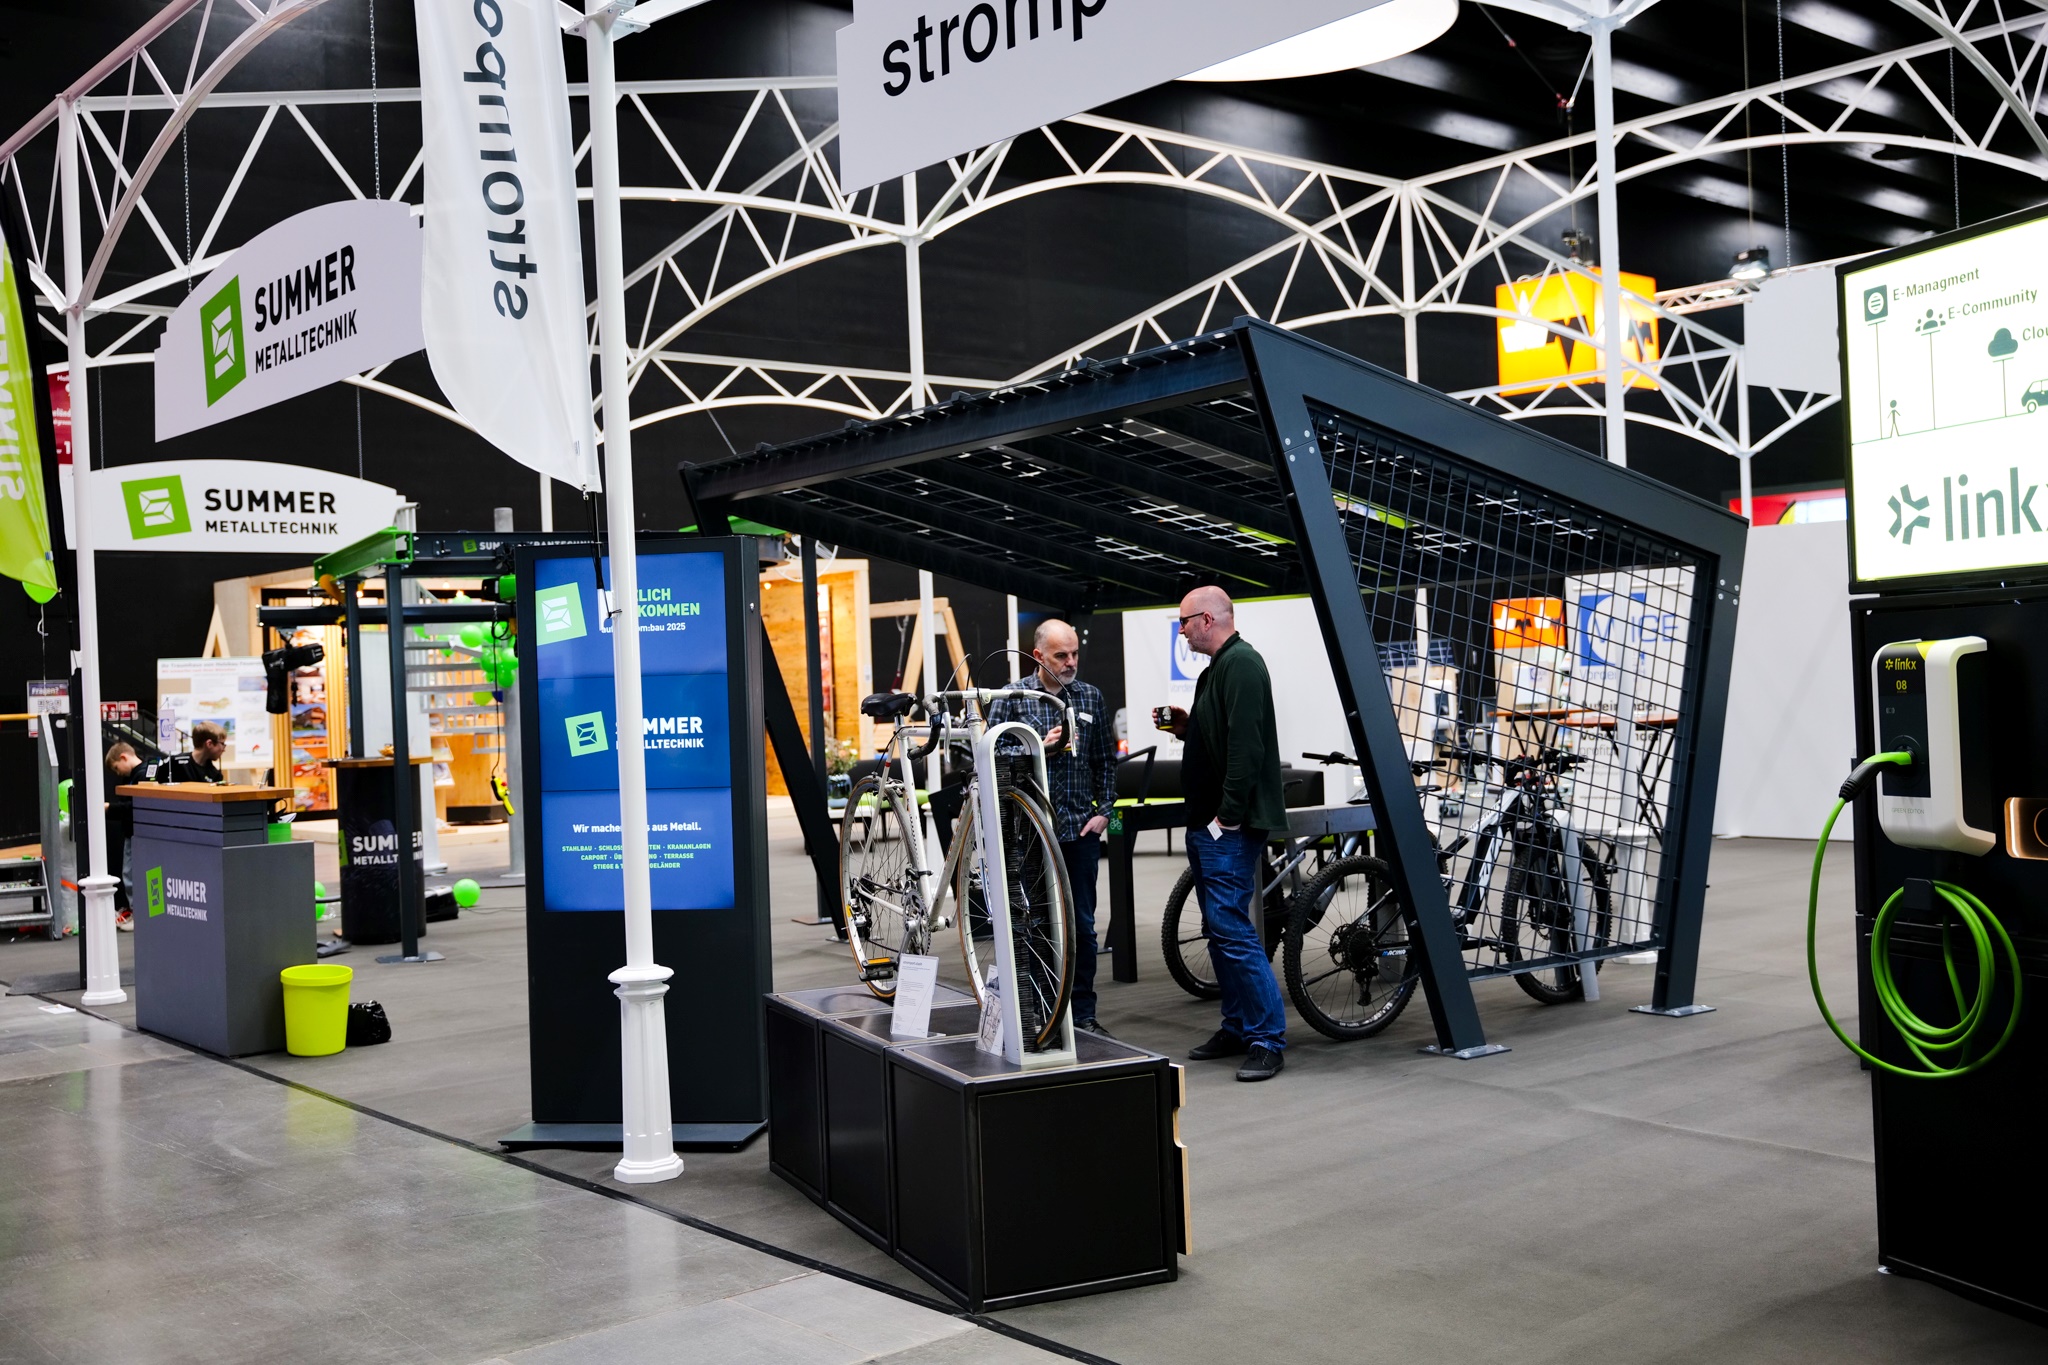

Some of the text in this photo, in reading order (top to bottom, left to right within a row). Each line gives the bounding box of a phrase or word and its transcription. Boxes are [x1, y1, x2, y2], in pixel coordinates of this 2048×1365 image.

[254, 244, 356, 333] SUMMER
[1893, 268, 1980, 301] E-Managment
[1948, 289, 2038, 319] E-Community
[255, 308, 357, 374] METALLTECHNIK
[204, 488, 336, 514] SUMMER
[1943, 467, 2048, 542] link
[205, 520, 338, 535] METALLTECHNIK
[637, 588, 671, 601] LICH
[637, 603, 701, 617] KOMMEN
[666, 622, 686, 631] 2025
[1894, 657, 1917, 670] linkx
[1896, 680, 1907, 690] 08
[616, 716, 704, 735] MMER
[616, 738, 705, 750] LLTECHNIK
[572, 824, 589, 833] Wir
[591, 823, 622, 832] mache
[652, 824, 669, 832] aus
[670, 821, 702, 831] Metall.
[166, 877, 207, 904] SUMMER
[166, 903, 208, 922] METALLTECHNIK
